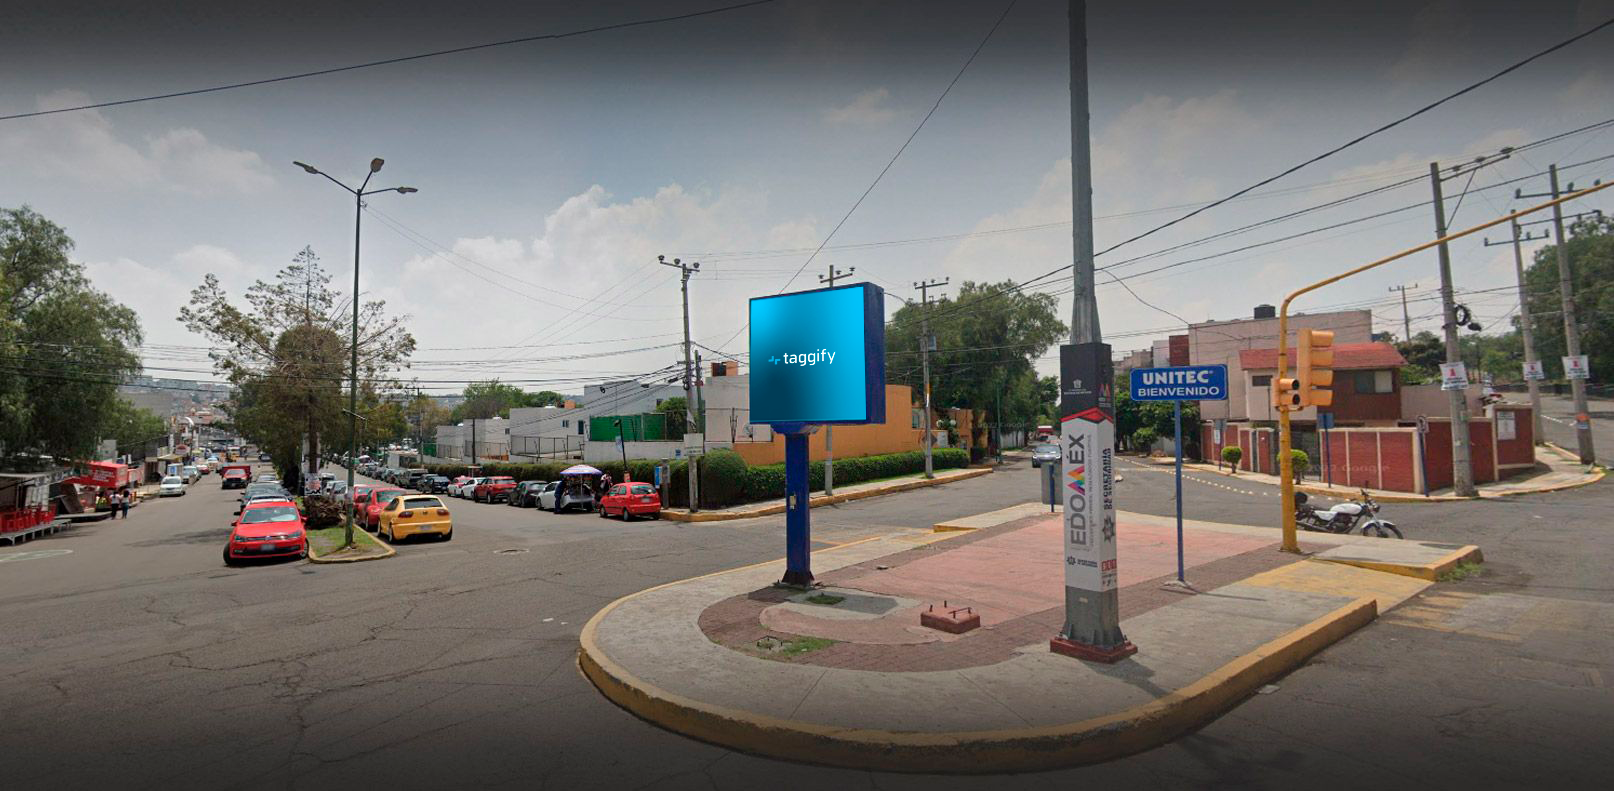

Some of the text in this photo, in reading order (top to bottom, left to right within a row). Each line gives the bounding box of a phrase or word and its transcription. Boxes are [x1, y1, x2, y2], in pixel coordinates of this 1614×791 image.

[783, 348, 836, 367] taggify
[1142, 370, 1209, 385] UNITEC
[1138, 386, 1220, 397] BIENVENIDO
